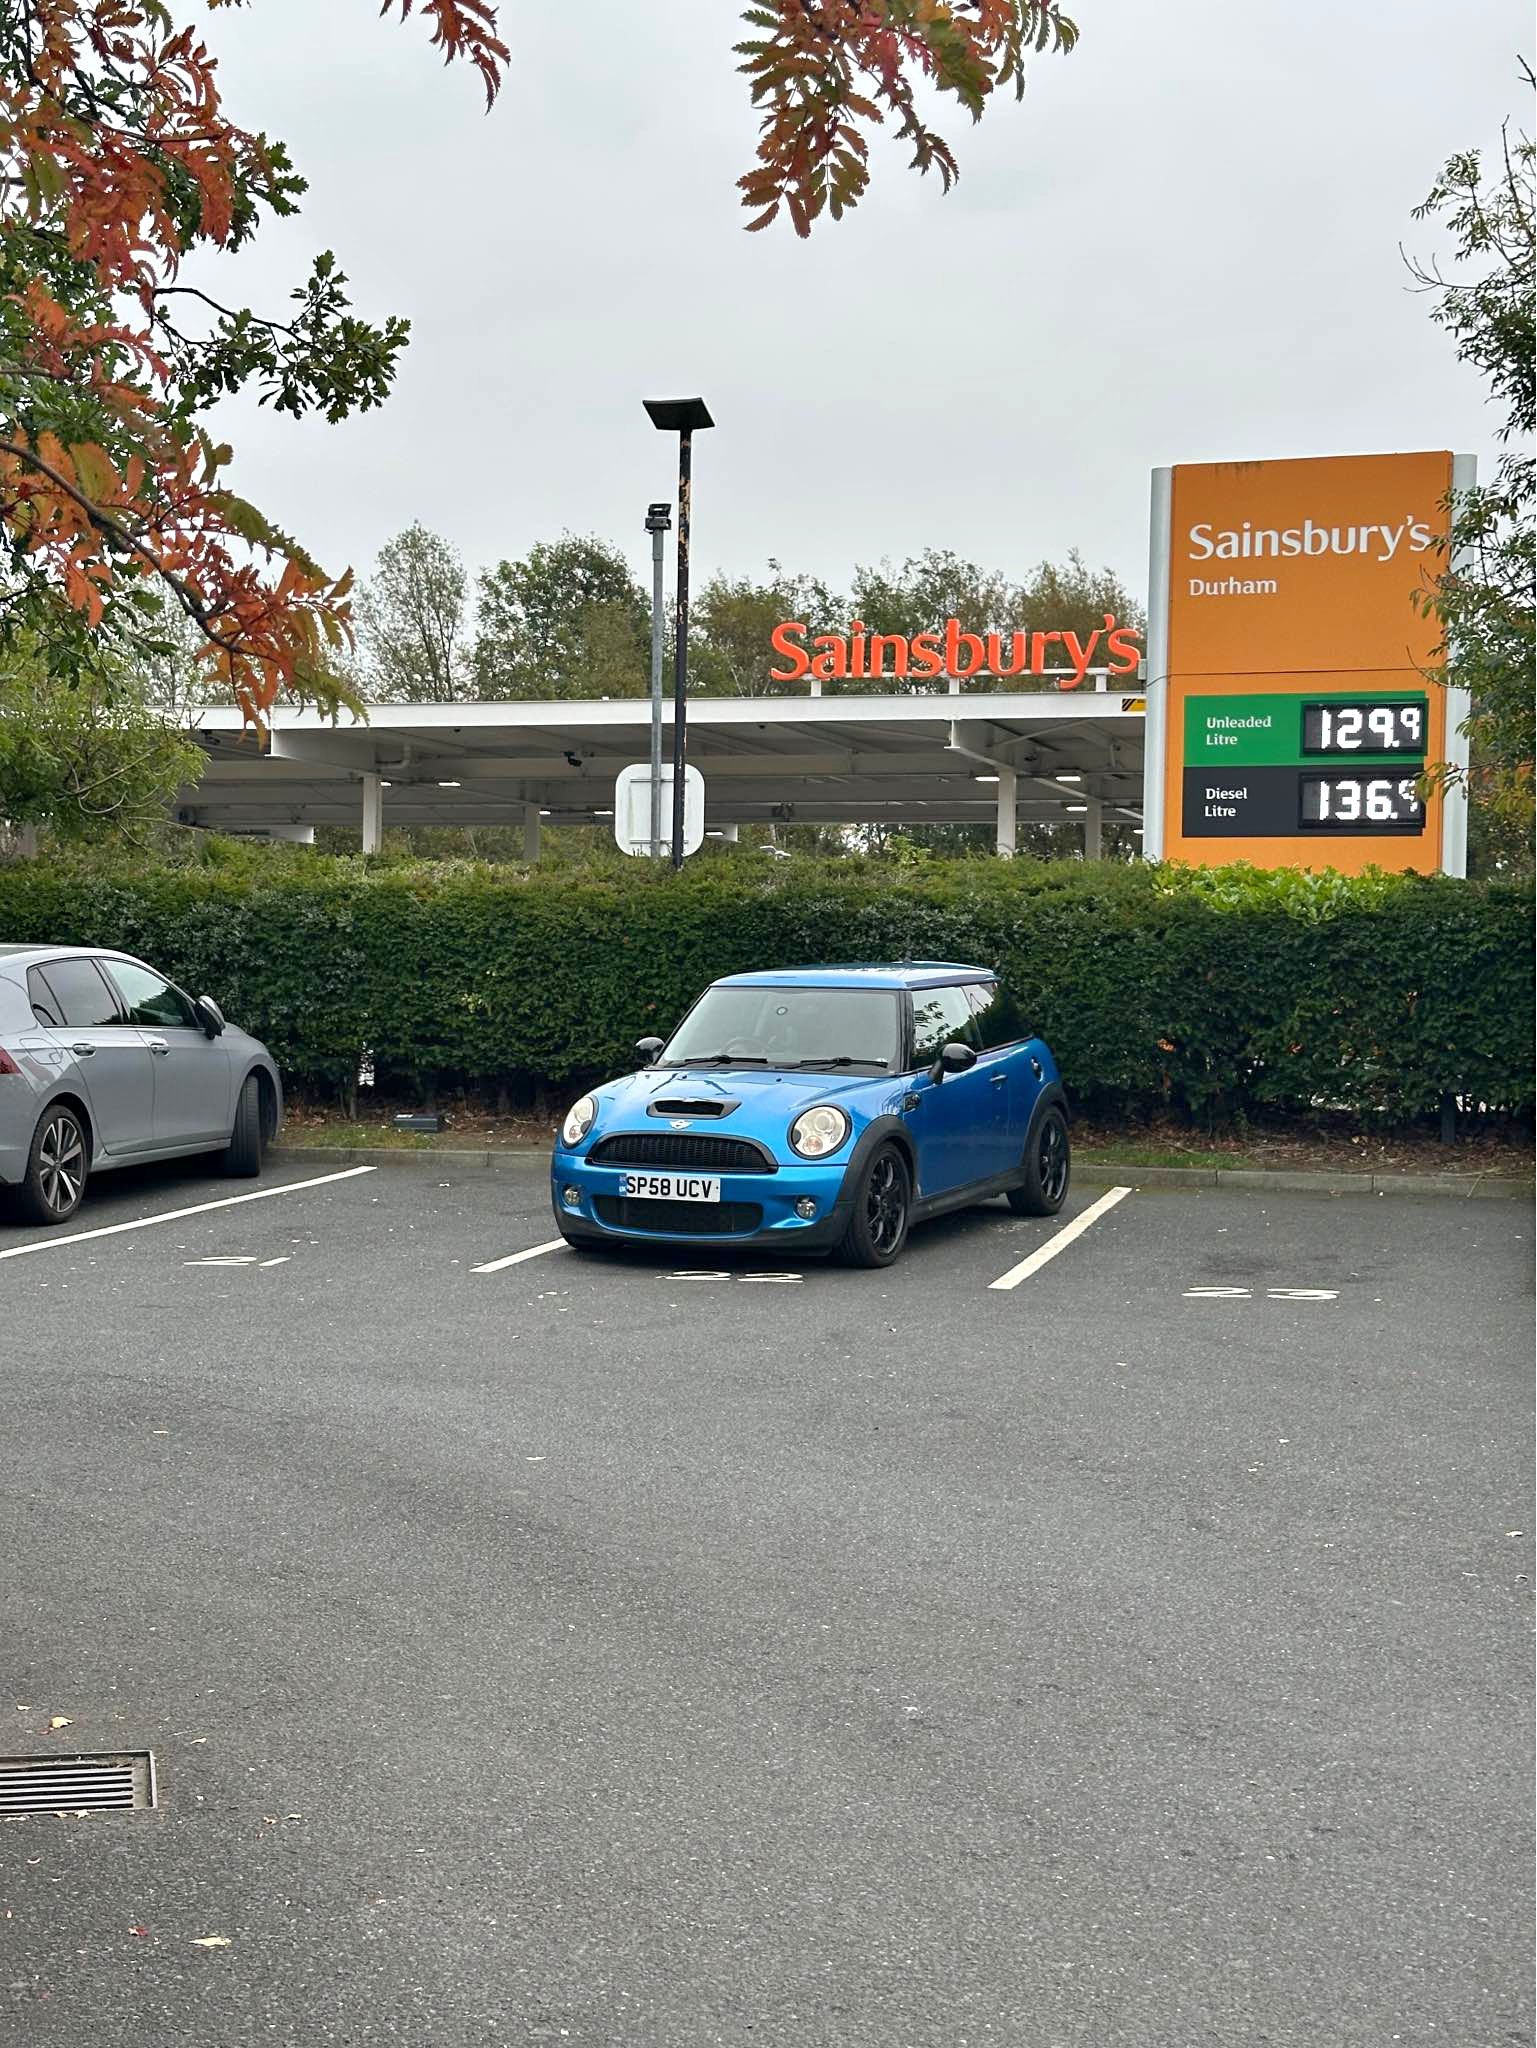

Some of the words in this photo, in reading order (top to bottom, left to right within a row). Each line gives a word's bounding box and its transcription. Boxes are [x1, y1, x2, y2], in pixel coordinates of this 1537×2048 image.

[1189, 515, 1430, 561] Sainsbury’s
[1189, 576, 1277, 596] Durham
[771, 613, 1142, 690] Sainsbury’s
[1206, 716, 1272, 729] Unleaded
[1321, 707, 1420, 749] 129.9
[1206, 733, 1238, 746] Litre
[1205, 787, 1248, 800] Diesel
[1204, 805, 1237, 817] Litre
[626, 1176, 671, 1196] SP58
[676, 1179, 712, 1199] UCV
[661, 1270, 803, 1282] 22
[1181, 1286, 1340, 1300] 23
